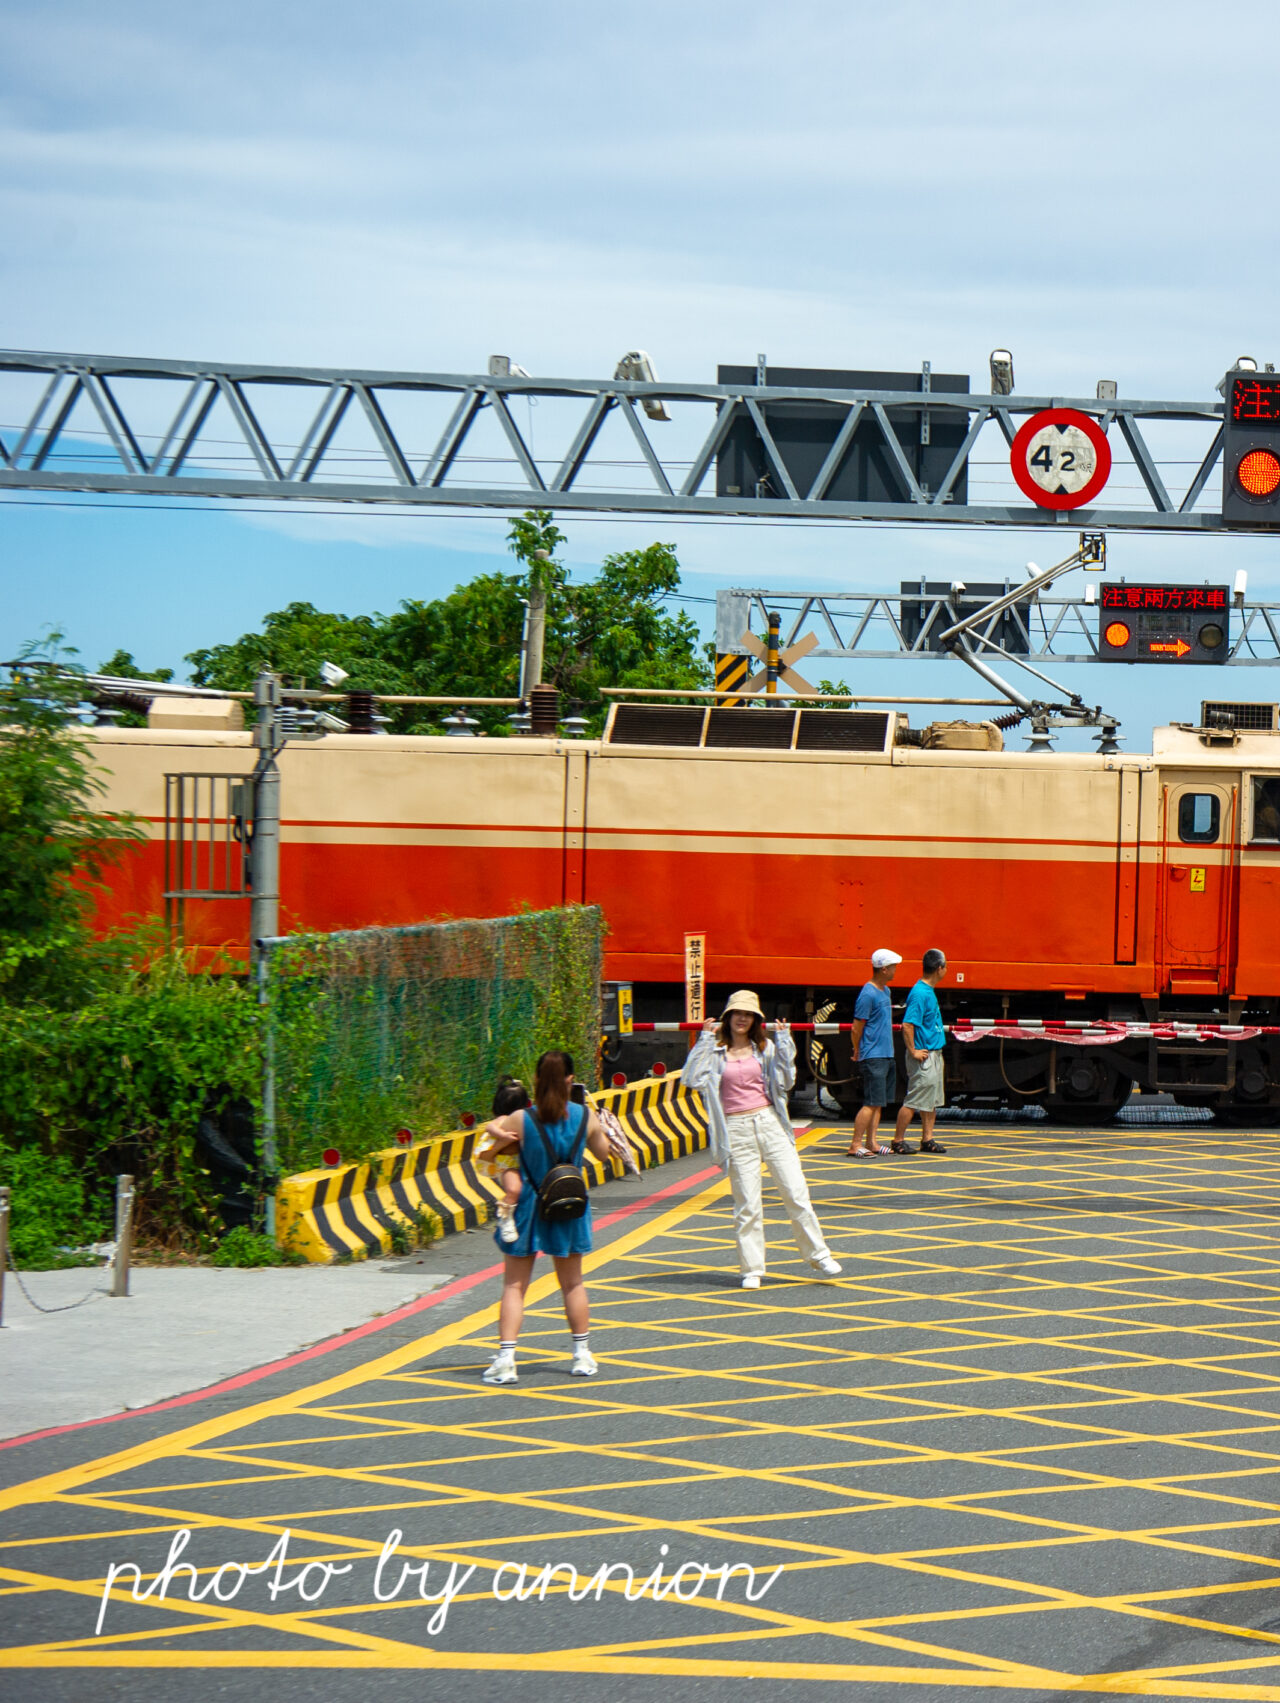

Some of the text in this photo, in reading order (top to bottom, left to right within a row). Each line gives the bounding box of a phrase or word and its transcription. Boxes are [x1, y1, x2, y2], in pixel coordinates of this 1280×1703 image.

[1103, 586, 1226, 610] 注意兩方來車
[690, 939, 701, 1020] 禁止通行
